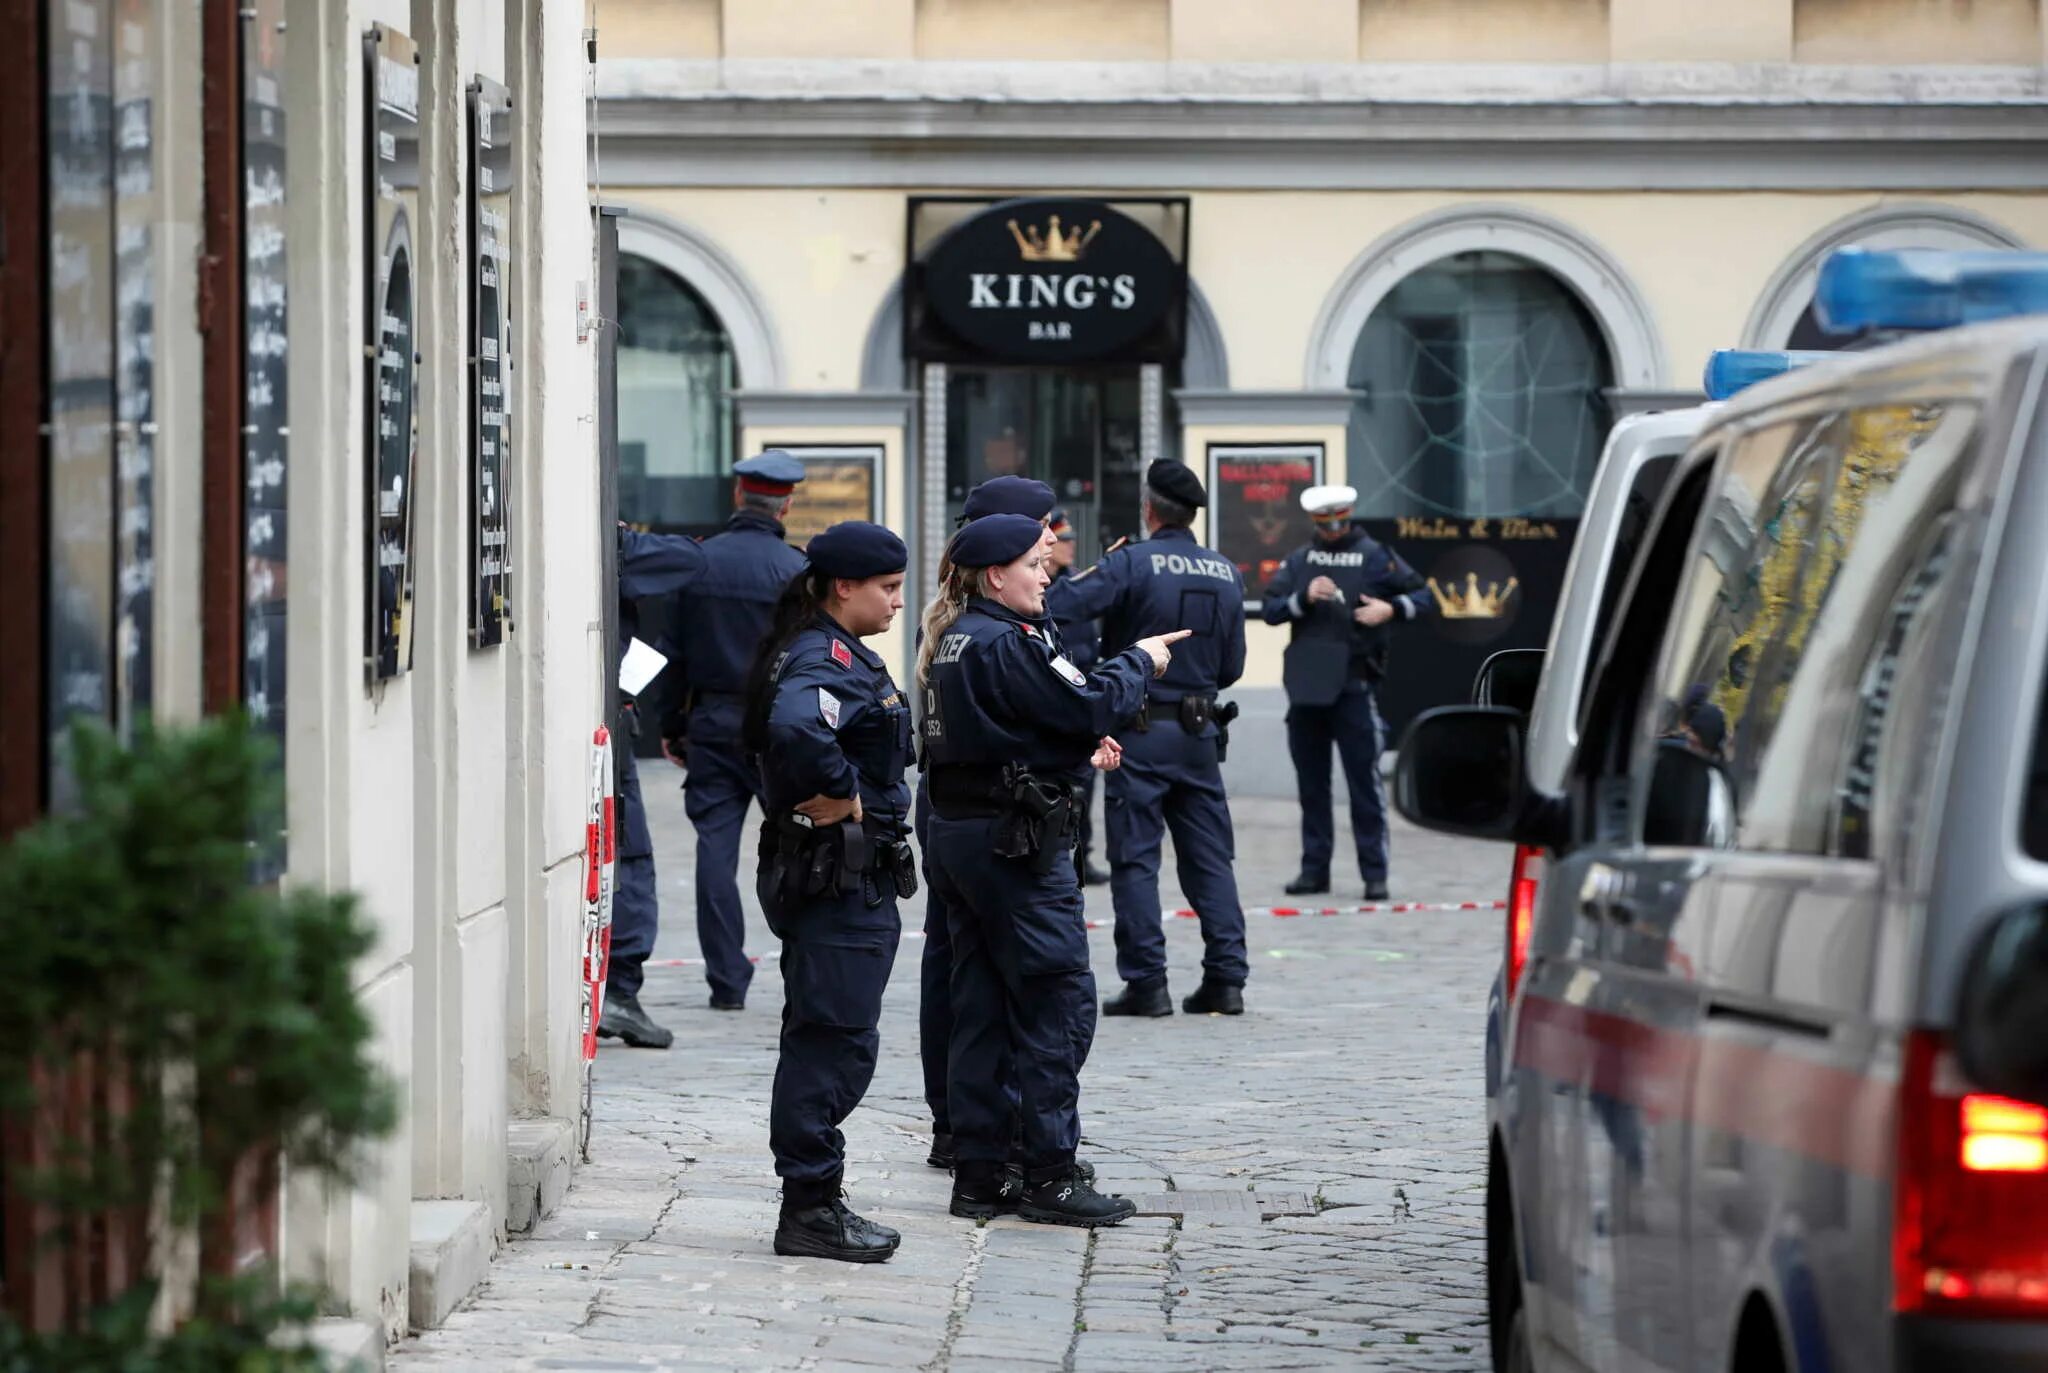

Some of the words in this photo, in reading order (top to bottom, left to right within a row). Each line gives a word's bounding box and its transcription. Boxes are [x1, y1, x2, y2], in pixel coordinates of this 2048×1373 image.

[1028, 322, 1072, 340] BAR
[1469, 517, 1490, 539] &
[1151, 554, 1235, 584] POLIZEI
[1306, 550, 1363, 568] POLIZEI
[927, 688, 936, 715] D
